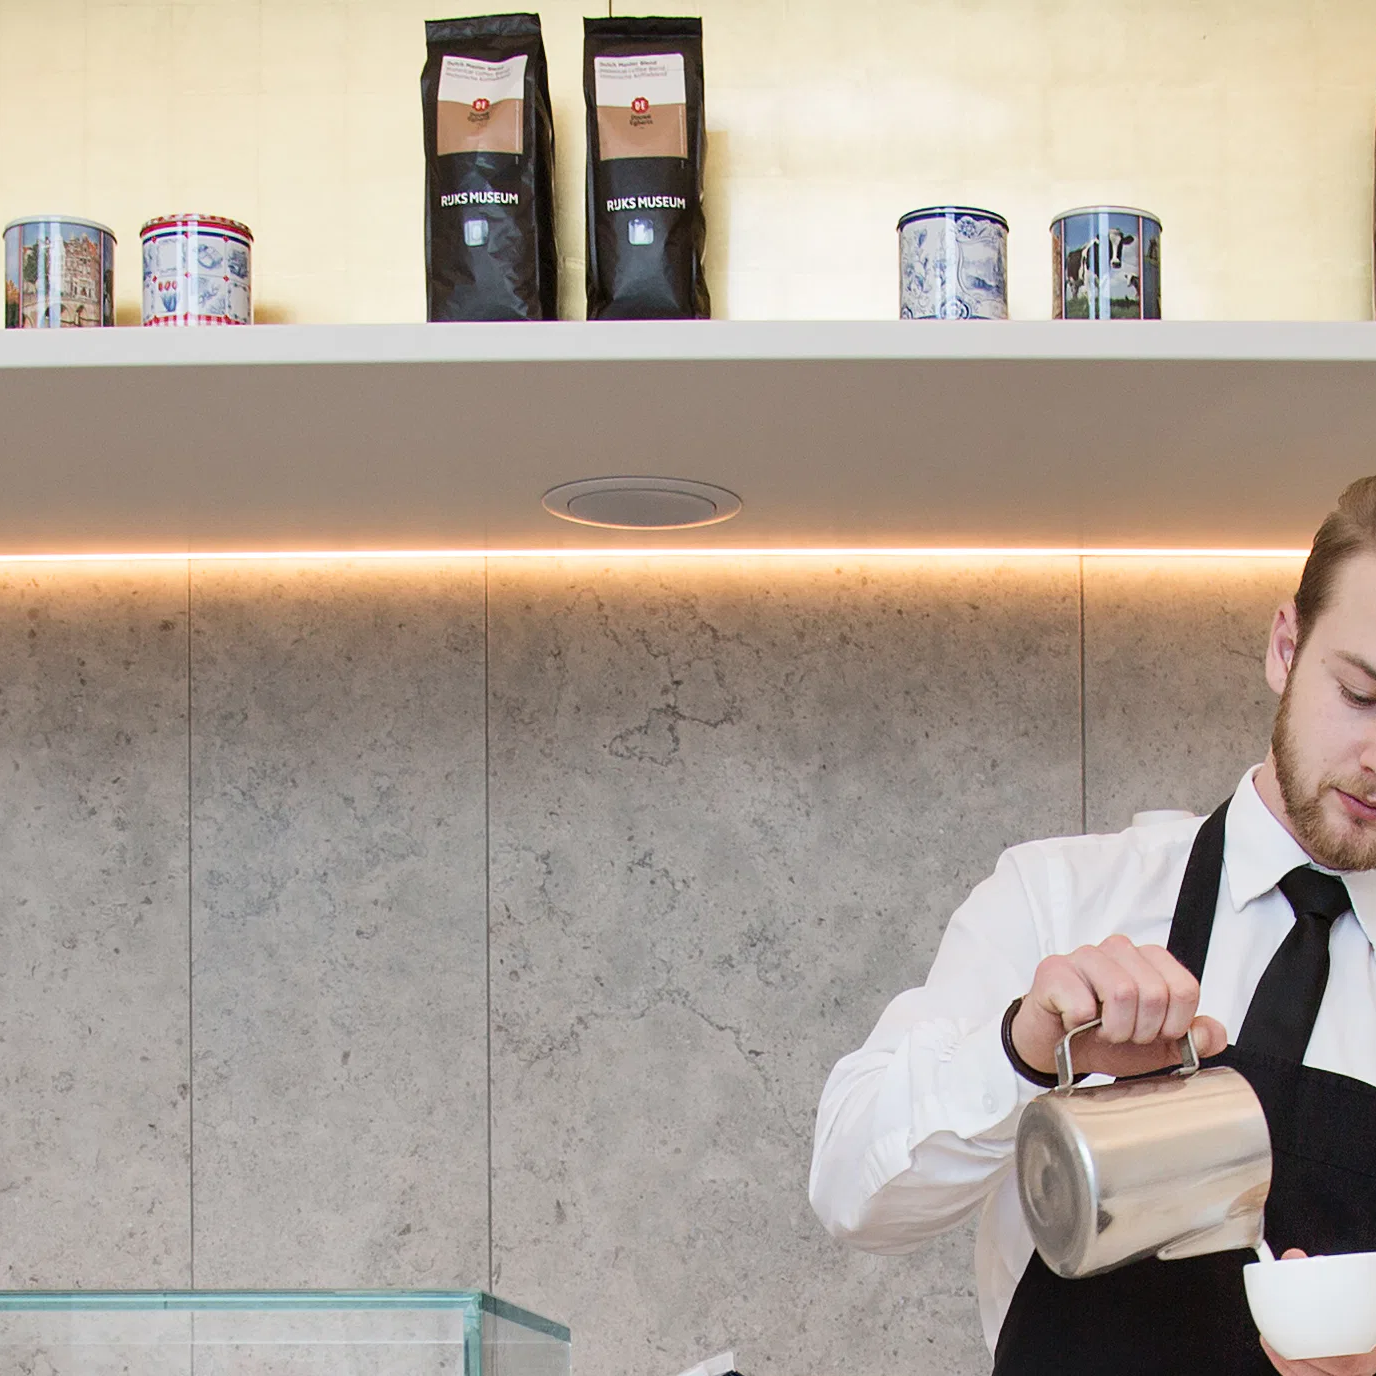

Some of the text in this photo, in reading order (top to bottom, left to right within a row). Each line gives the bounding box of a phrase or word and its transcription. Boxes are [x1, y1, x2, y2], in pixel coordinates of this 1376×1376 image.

[441, 191, 518, 207] RIJKS MUSEUM
[606, 197, 686, 212] RIJKS MUSEUM
